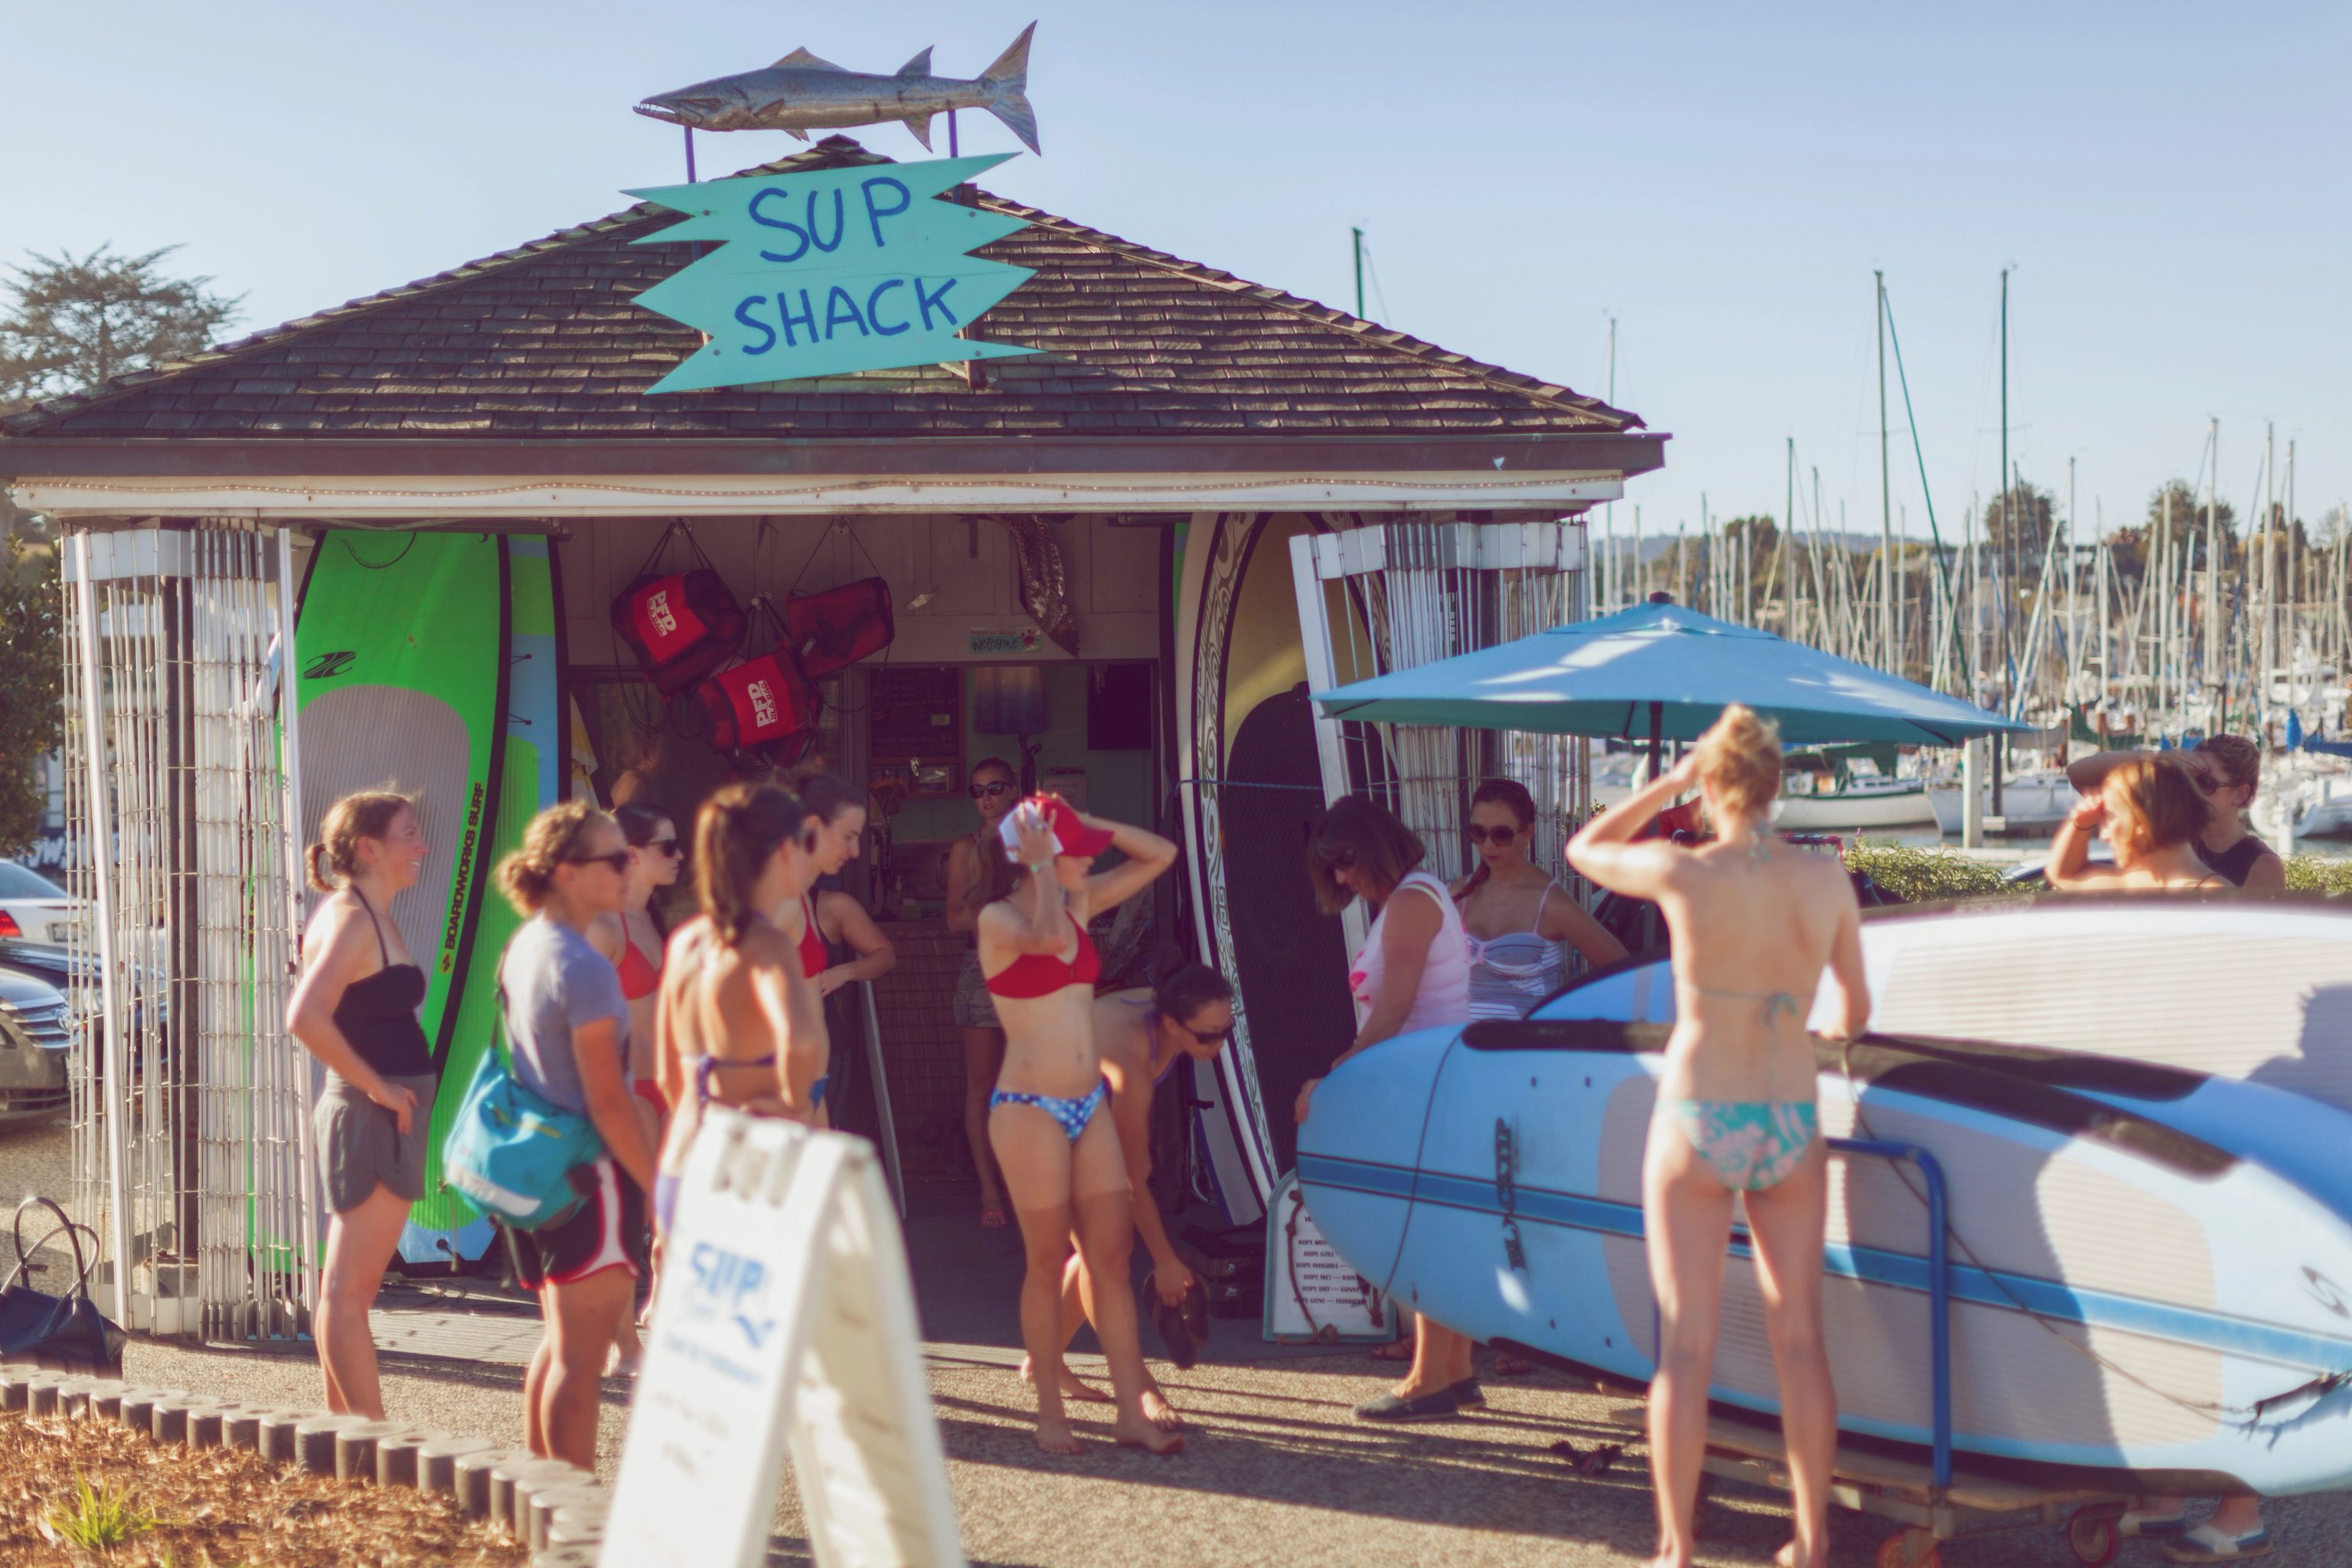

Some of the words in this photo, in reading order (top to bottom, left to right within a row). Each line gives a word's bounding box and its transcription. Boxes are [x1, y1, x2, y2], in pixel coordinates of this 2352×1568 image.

[748, 176, 911, 263] SUP
[734, 277, 958, 355] SHACK
[654, 590, 677, 631] PFD
[748, 683, 770, 728] PFD
[444, 829, 476, 950] BOARDWORKS
[468, 782, 485, 827] SURF
